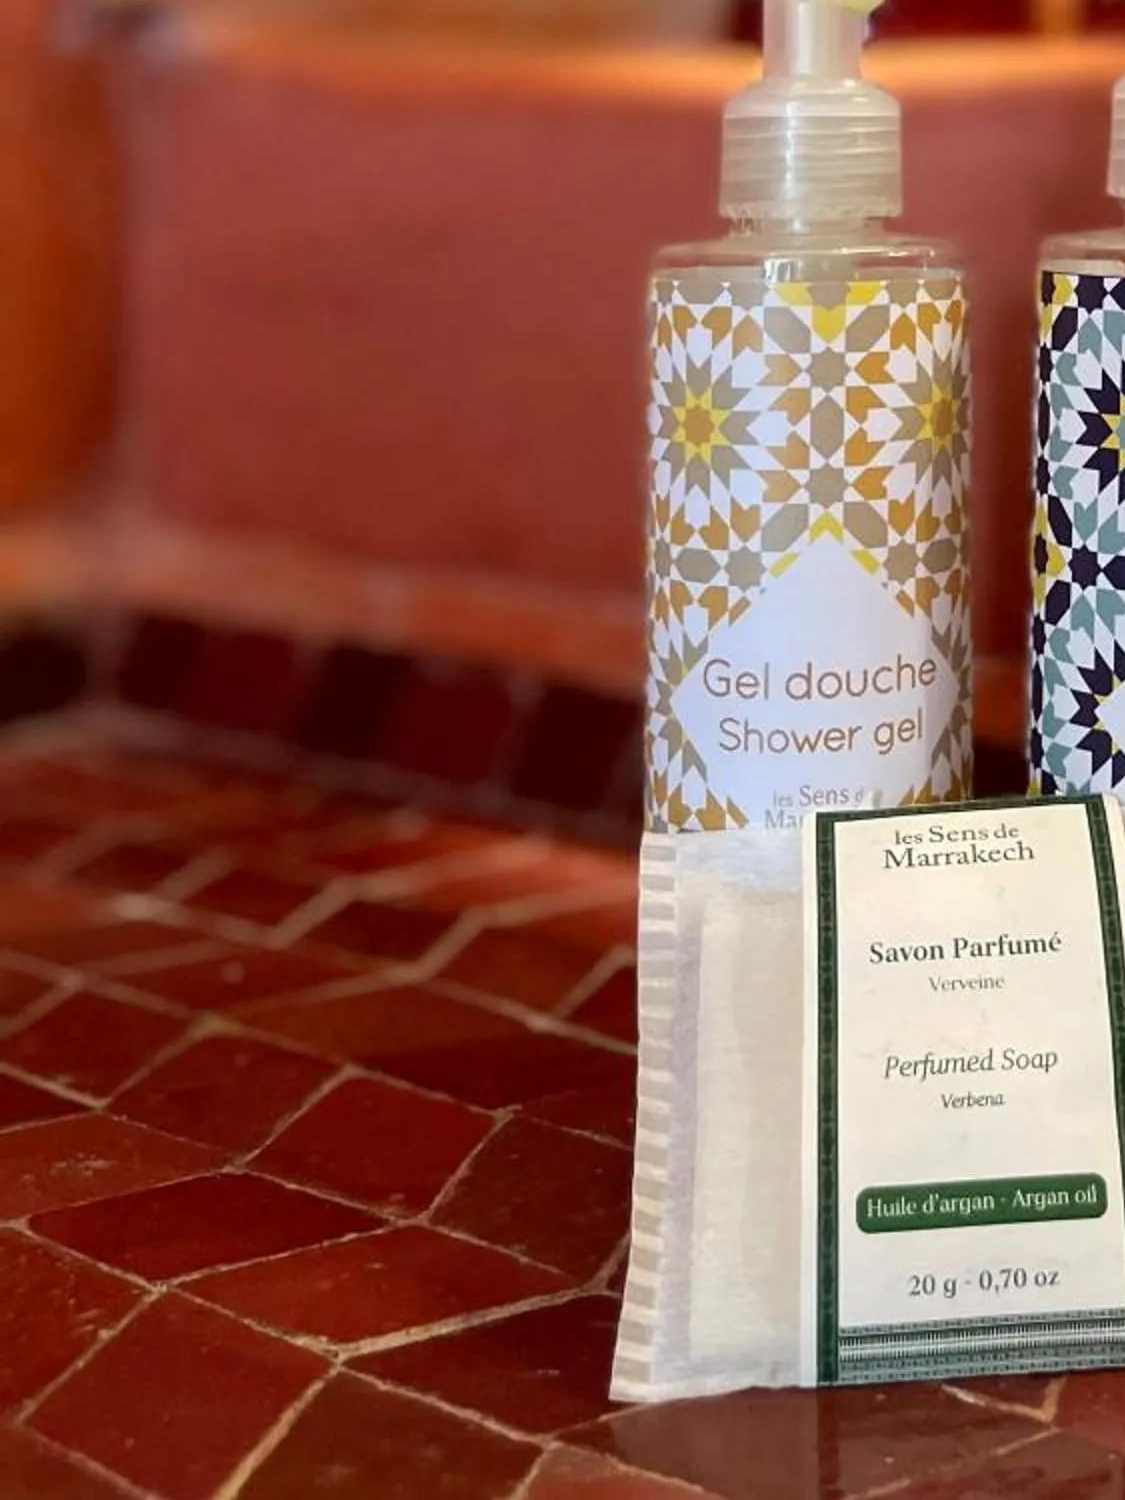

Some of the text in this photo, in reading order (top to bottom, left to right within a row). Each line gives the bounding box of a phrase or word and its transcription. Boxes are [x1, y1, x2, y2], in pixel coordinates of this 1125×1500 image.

[703, 653, 937, 701] Gel douche
[718, 707, 923, 755] Shower gel
[772, 789, 793, 807] les
[799, 784, 848, 807] Sens
[894, 822, 1021, 845] les Sens de
[883, 840, 1034, 869] Marrakech
[868, 932, 1062, 964] Savon Parfumé
[928, 975, 1005, 992] Verveine
[883, 1048, 1058, 1082] Perfumed Soap
[940, 1091, 1006, 1109] Verbena
[867, 1196, 917, 1219] Huile
[922, 1193, 995, 1217] d'argan
[1011, 1187, 1069, 1209] Argan
[1075, 1184, 1097, 1204] oil
[908, 1274, 936, 1296] 20
[943, 1276, 957, 1298] g
[978, 1268, 1027, 1295] 0,70
[1034, 1268, 1060, 1287] oz
